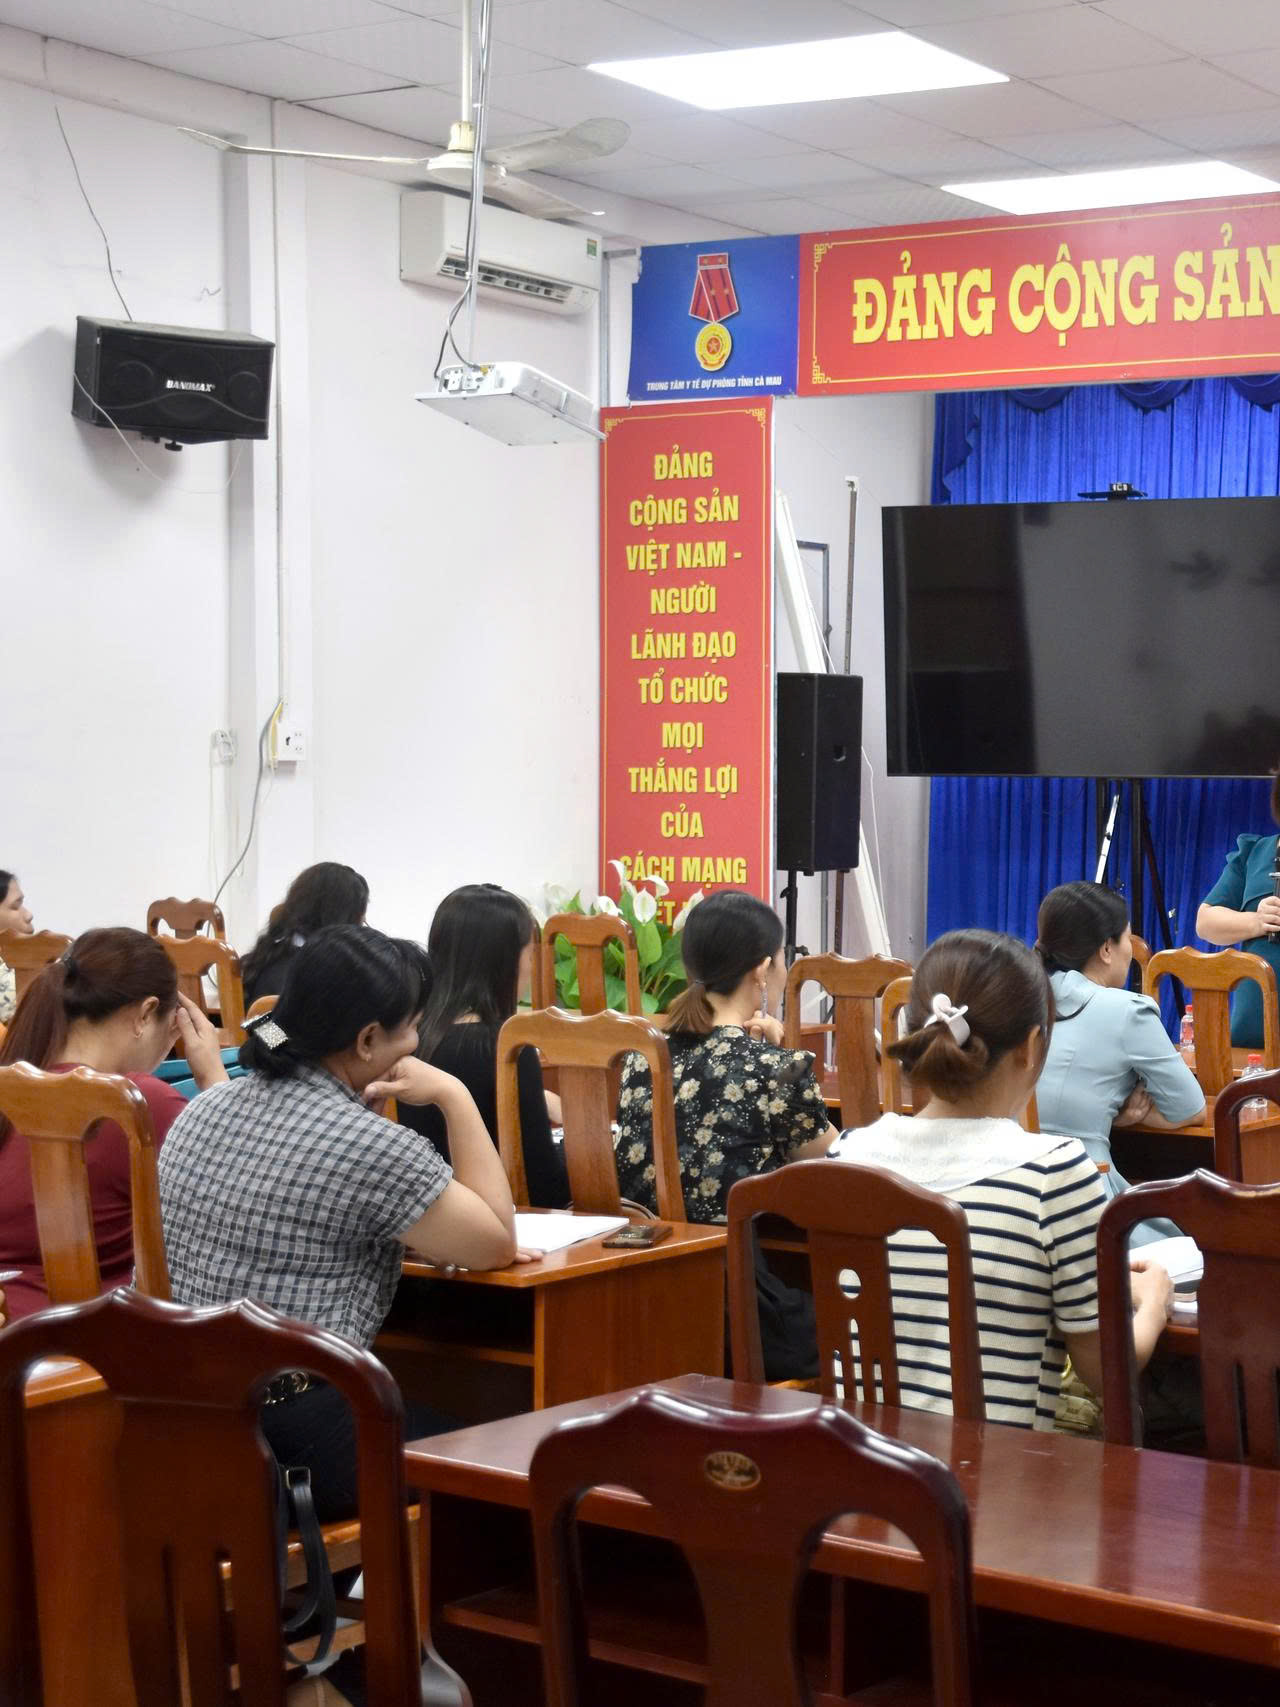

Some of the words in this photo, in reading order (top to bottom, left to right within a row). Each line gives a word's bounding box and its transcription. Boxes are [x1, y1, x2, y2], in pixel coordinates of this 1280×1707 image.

[852, 250, 996, 344] ĐẢNG
[1008, 243, 1160, 346] CỘNG
[647, 382, 669, 391] TRUNG
[670, 380, 685, 390] TÂM
[686, 381, 691, 389] Y
[754, 375, 764, 386] CÀ
[766, 376, 782, 386] MAU
[654, 444, 713, 480] ĐẢNG
[629, 494, 687, 531] CỘNG
[694, 487, 739, 523] SẢN
[626, 539, 670, 576] VIỆT
[676, 541, 726, 569] NAM
[651, 581, 717, 614] NGƯỜI
[631, 628, 686, 660] LÃNH
[692, 631, 736, 663] ĐẠO
[638, 667, 664, 704] TỔ
[670, 672, 728, 704] CHỨC
[662, 722, 704, 754] MỌI
[628, 757, 698, 793] THẮNG
[704, 764, 738, 799] LỢI
[661, 803, 704, 838] CỦA
[619, 850, 675, 882] CÁCH
[682, 856, 747, 889] MẠNG
